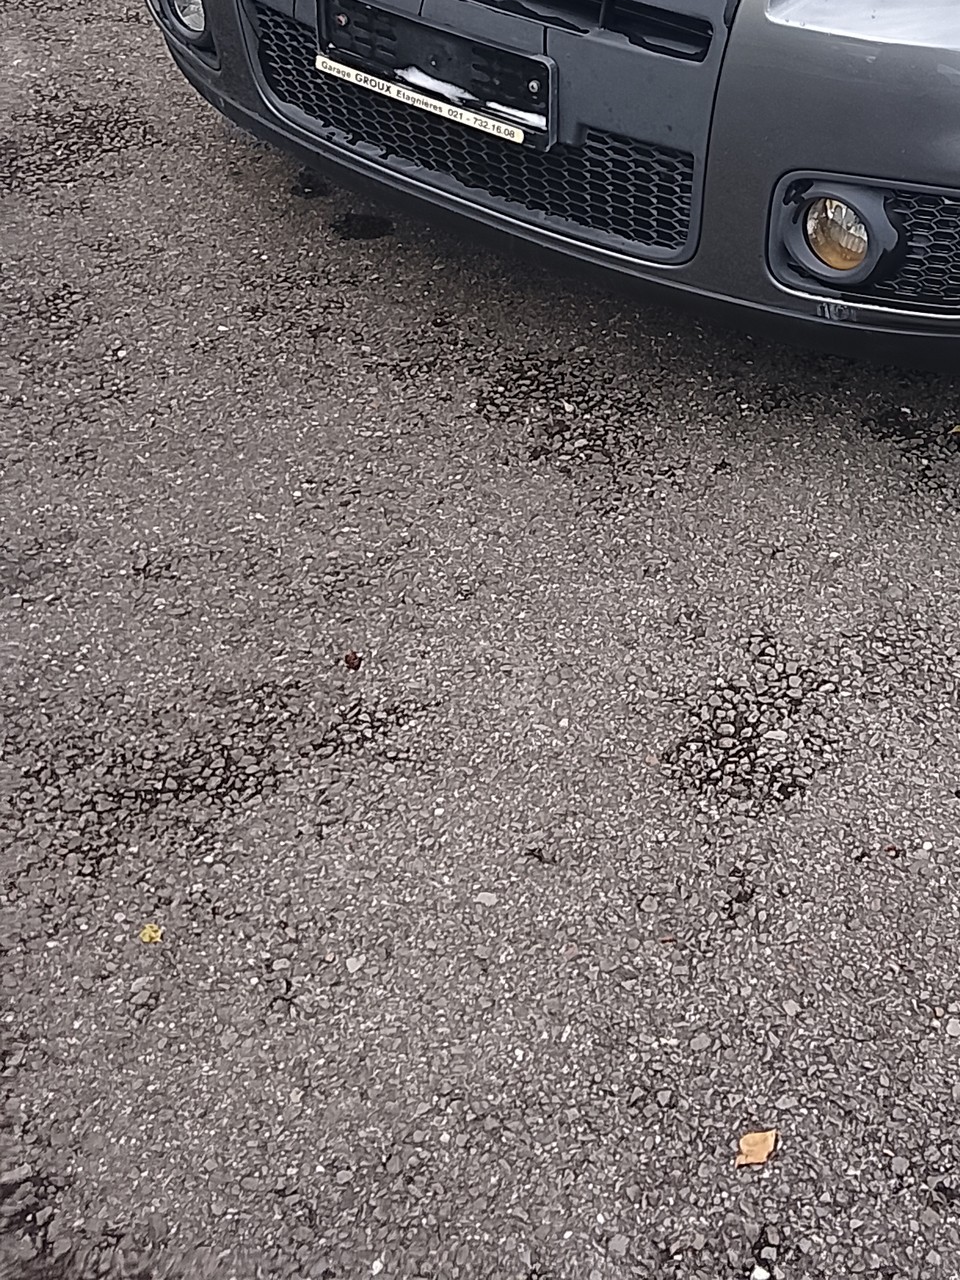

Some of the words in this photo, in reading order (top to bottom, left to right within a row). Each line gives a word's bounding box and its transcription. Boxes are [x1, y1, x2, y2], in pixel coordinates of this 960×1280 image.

[321, 60, 352, 79] Garage
[354, 72, 393, 95] GROUX
[447, 108, 465, 121] 021
[473, 117, 516, 139] 732.16.08
